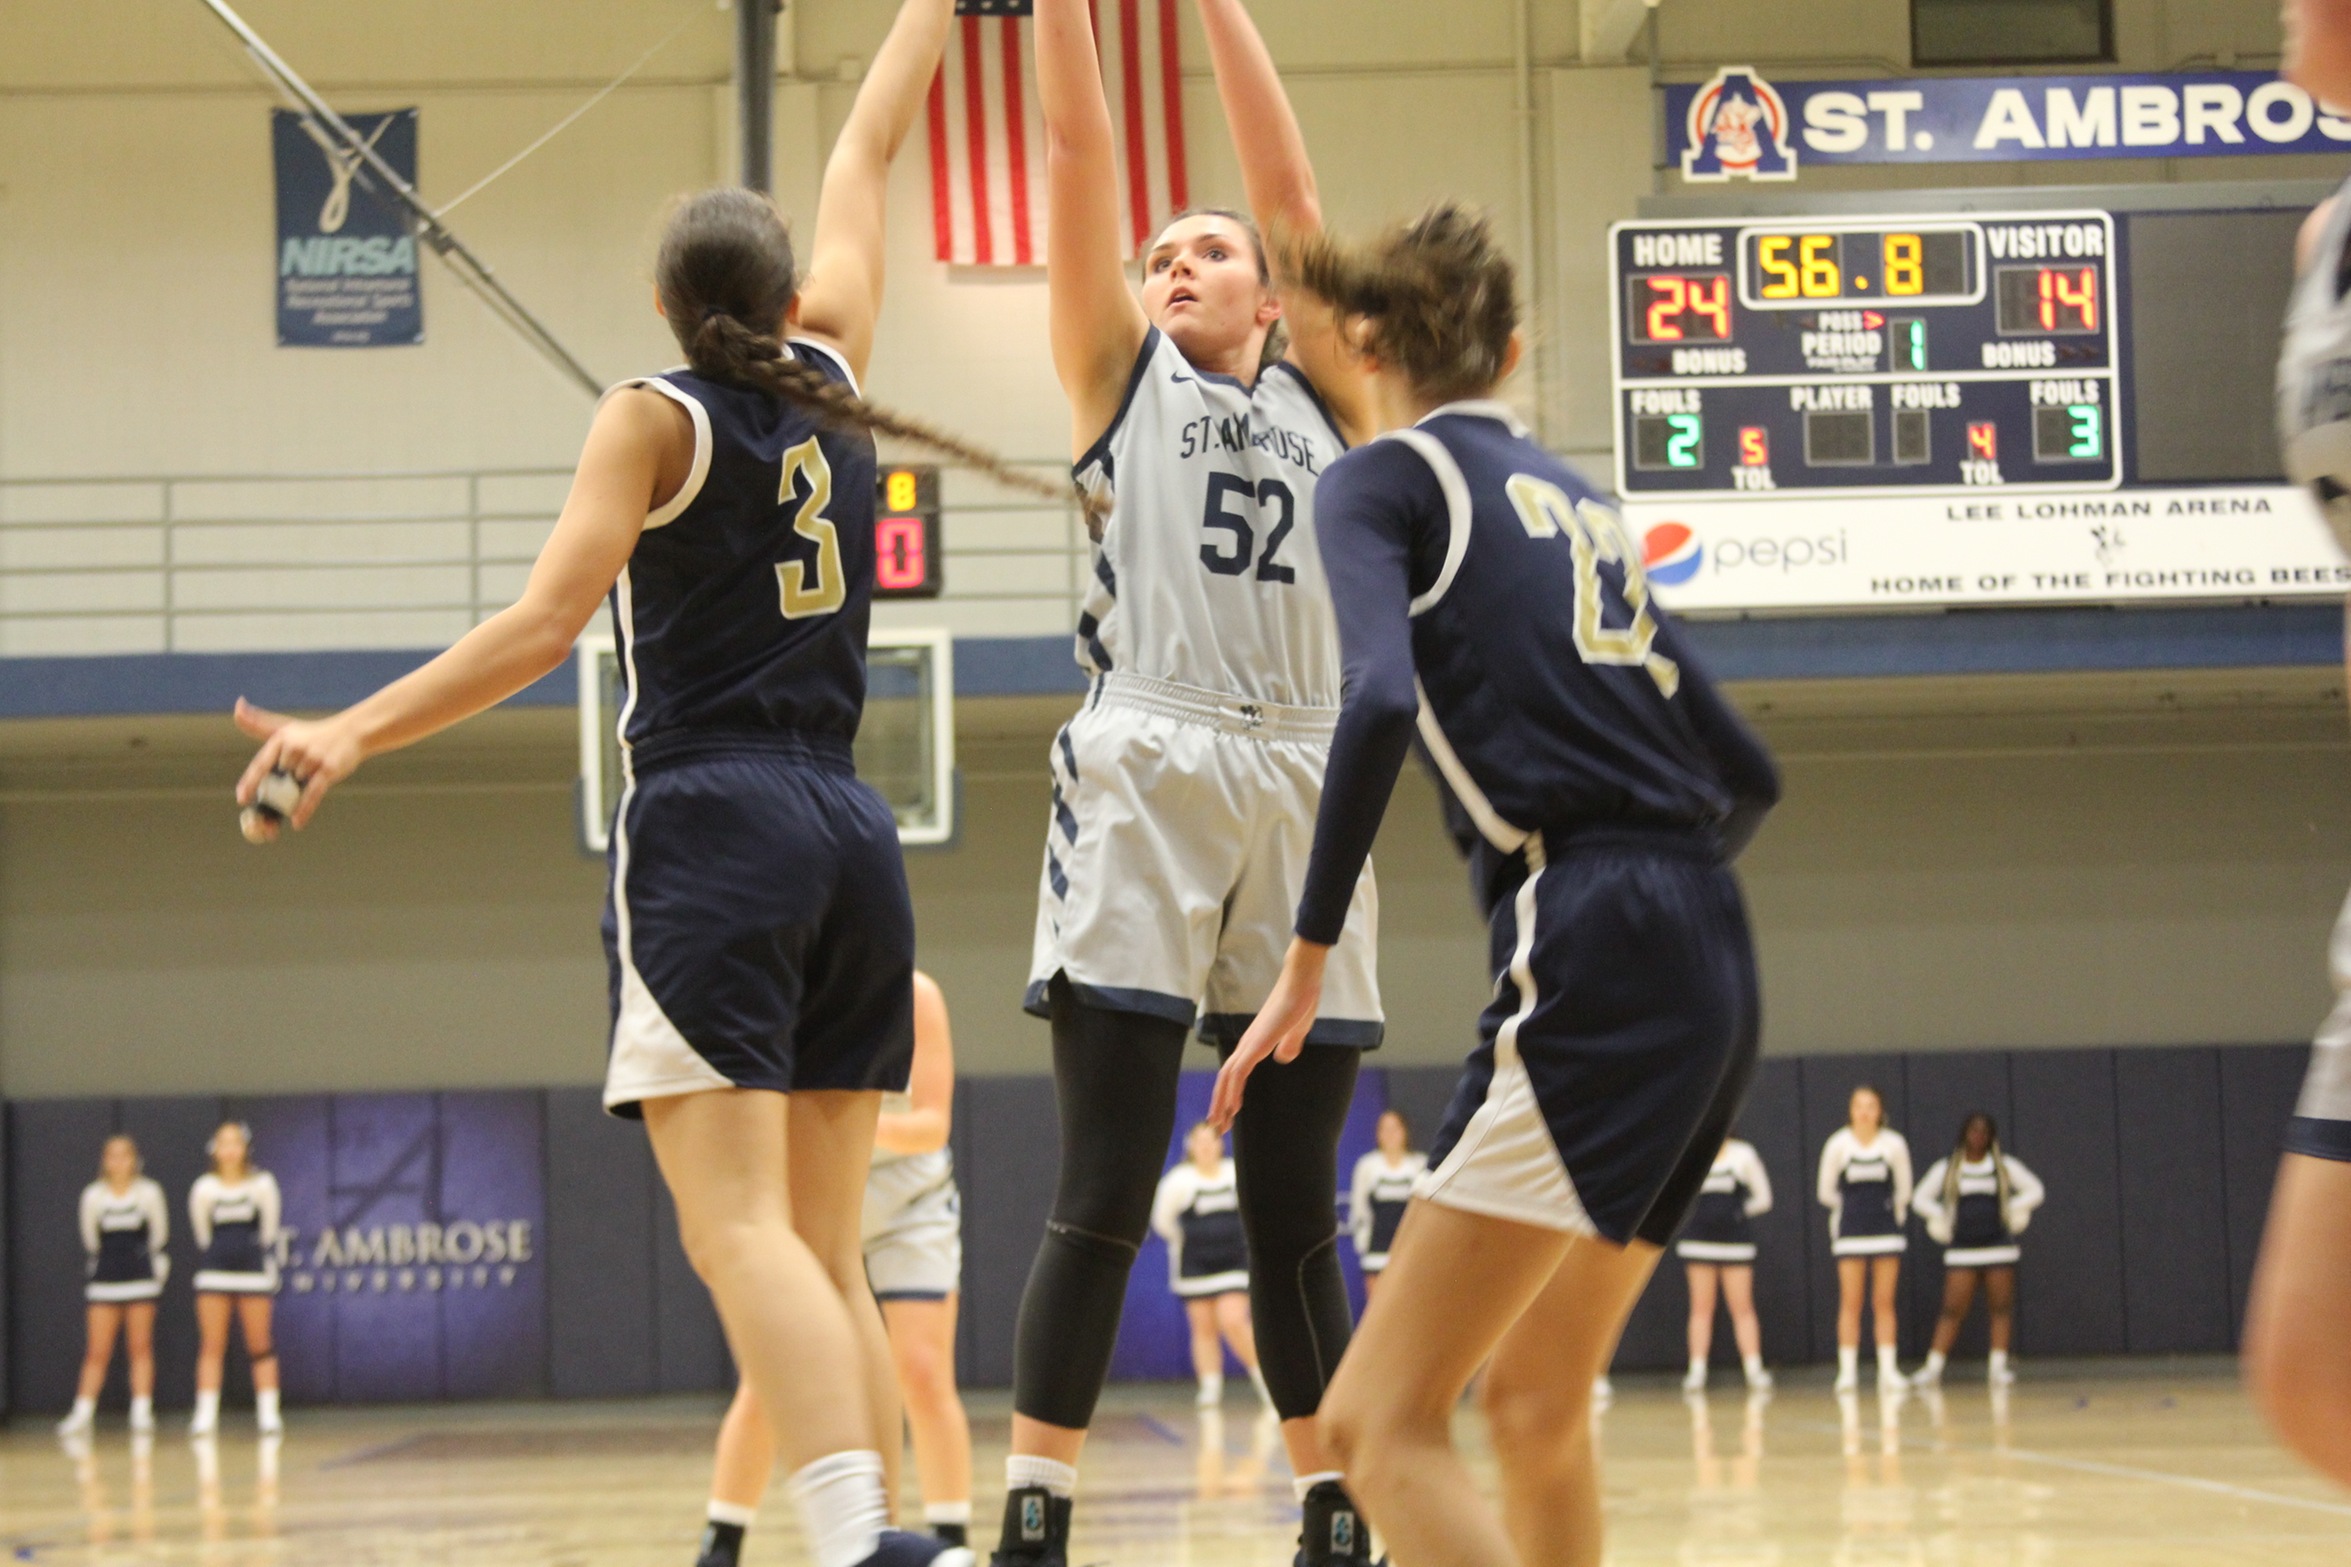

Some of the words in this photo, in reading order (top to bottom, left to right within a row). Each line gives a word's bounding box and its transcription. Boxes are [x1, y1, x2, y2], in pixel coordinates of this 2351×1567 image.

[1802, 91, 1934, 153] ST.
[281, 236, 415, 276] NIRSA
[1633, 233, 1723, 267] HOME
[1987, 224, 2105, 258] VISITOR
[1647, 275, 1730, 341] 24
[2039, 266, 2098, 331] 14
[1672, 348, 1747, 375] BONUS
[1801, 331, 1882, 357] PERIOD
[1911, 320, 1925, 371] 1
[1982, 341, 2056, 368] BONUS
[1630, 389, 1702, 414] FOULS
[1789, 386, 1874, 411] PLAYER
[1890, 382, 1961, 408] FOULS
[2029, 379, 2100, 404] FOULS
[1667, 413, 1701, 468] 2
[1968, 422, 1996, 460] 4
[2067, 404, 2100, 457] 3
[887, 470, 917, 512] 8
[1731, 465, 1776, 490] TOL
[1959, 460, 2004, 485] TOL
[774, 434, 846, 620] 3
[1199, 471, 1295, 585] 52
[1947, 505, 2002, 520] LEE
[2018, 502, 2150, 518] LOHMAN
[2166, 498, 2272, 515] ARENA
[875, 516, 924, 589] 0
[1713, 528, 1847, 575] pepsi
[1871, 575, 1963, 593] HOME
[1978, 574, 2018, 590] OF
[2032, 573, 2090, 588] THE
[2106, 568, 2256, 587] FIGHTING
[314, 1219, 532, 1267] AMBROSE
